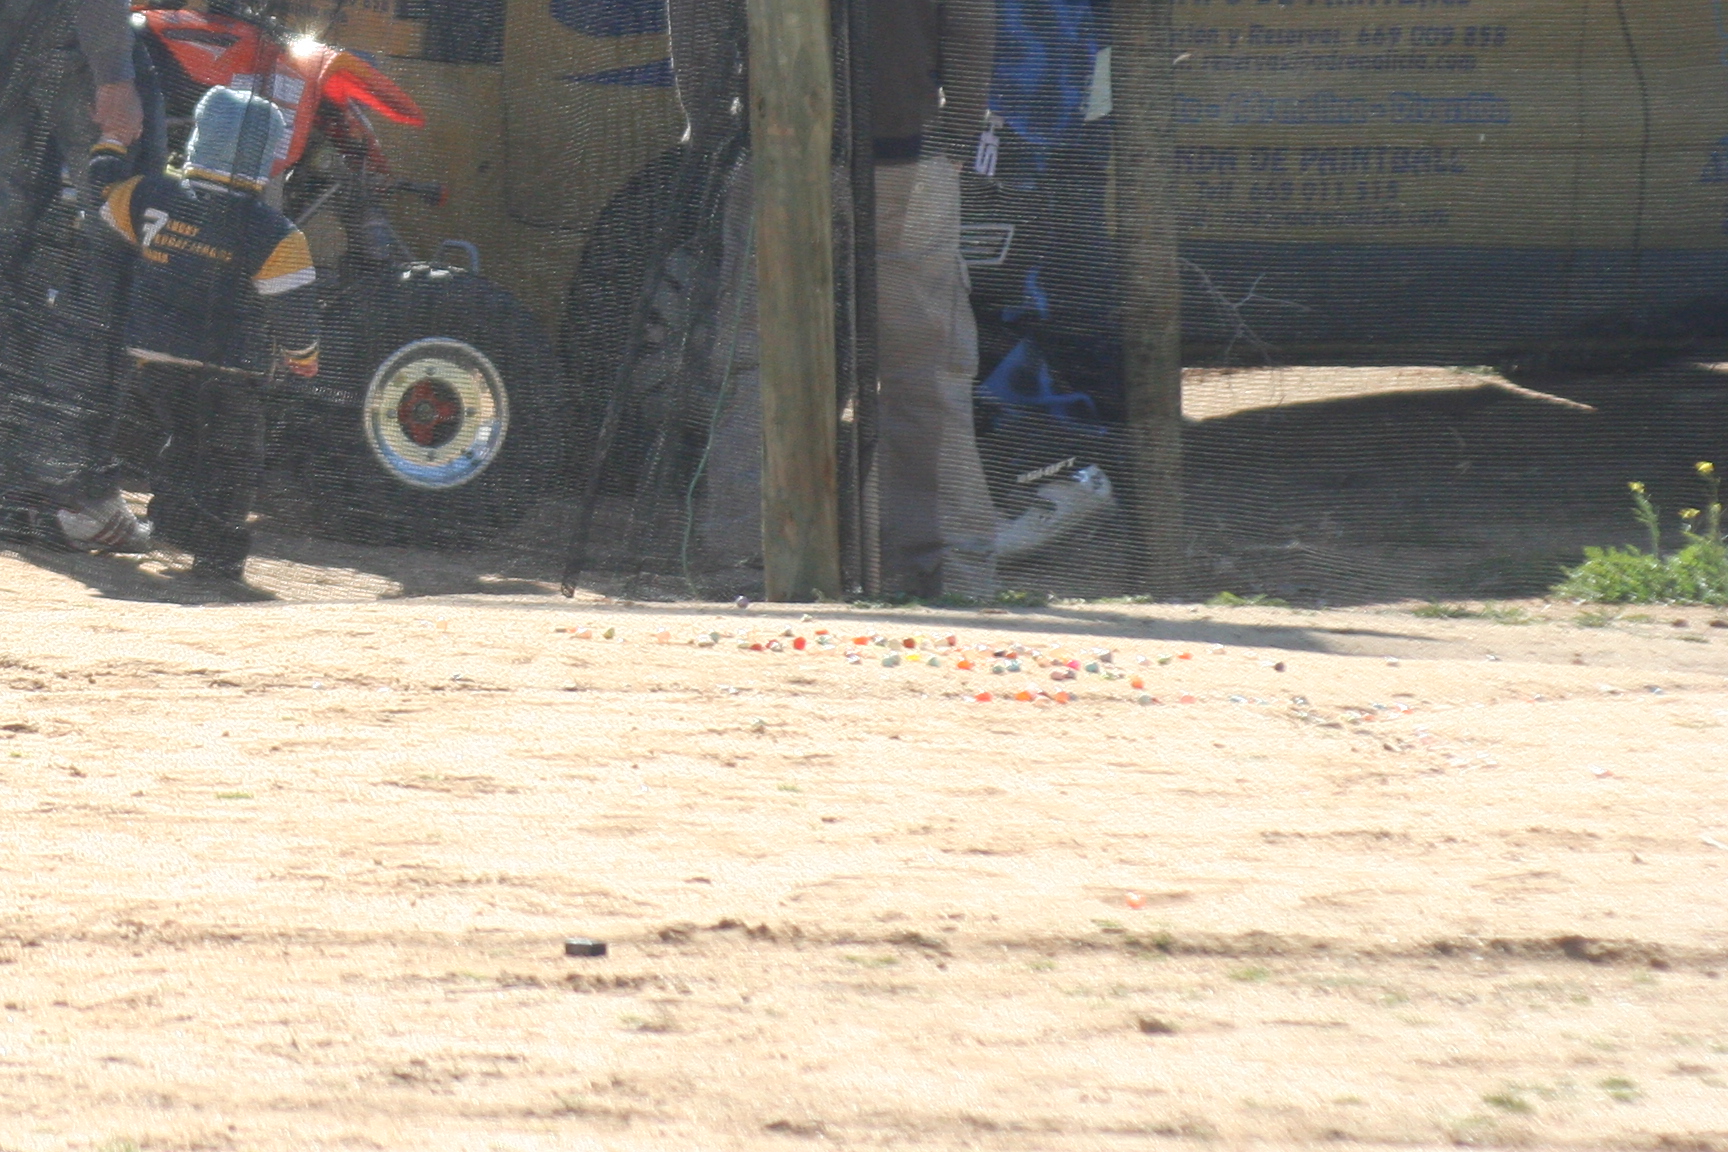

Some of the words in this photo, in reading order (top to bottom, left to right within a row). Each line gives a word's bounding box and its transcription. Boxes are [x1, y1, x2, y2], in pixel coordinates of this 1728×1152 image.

[1357, 25, 1402, 48] 669
[1250, 145, 1290, 175] DE
[1300, 145, 1466, 175] PAINTBALL
[142, 207, 169, 247] 7
